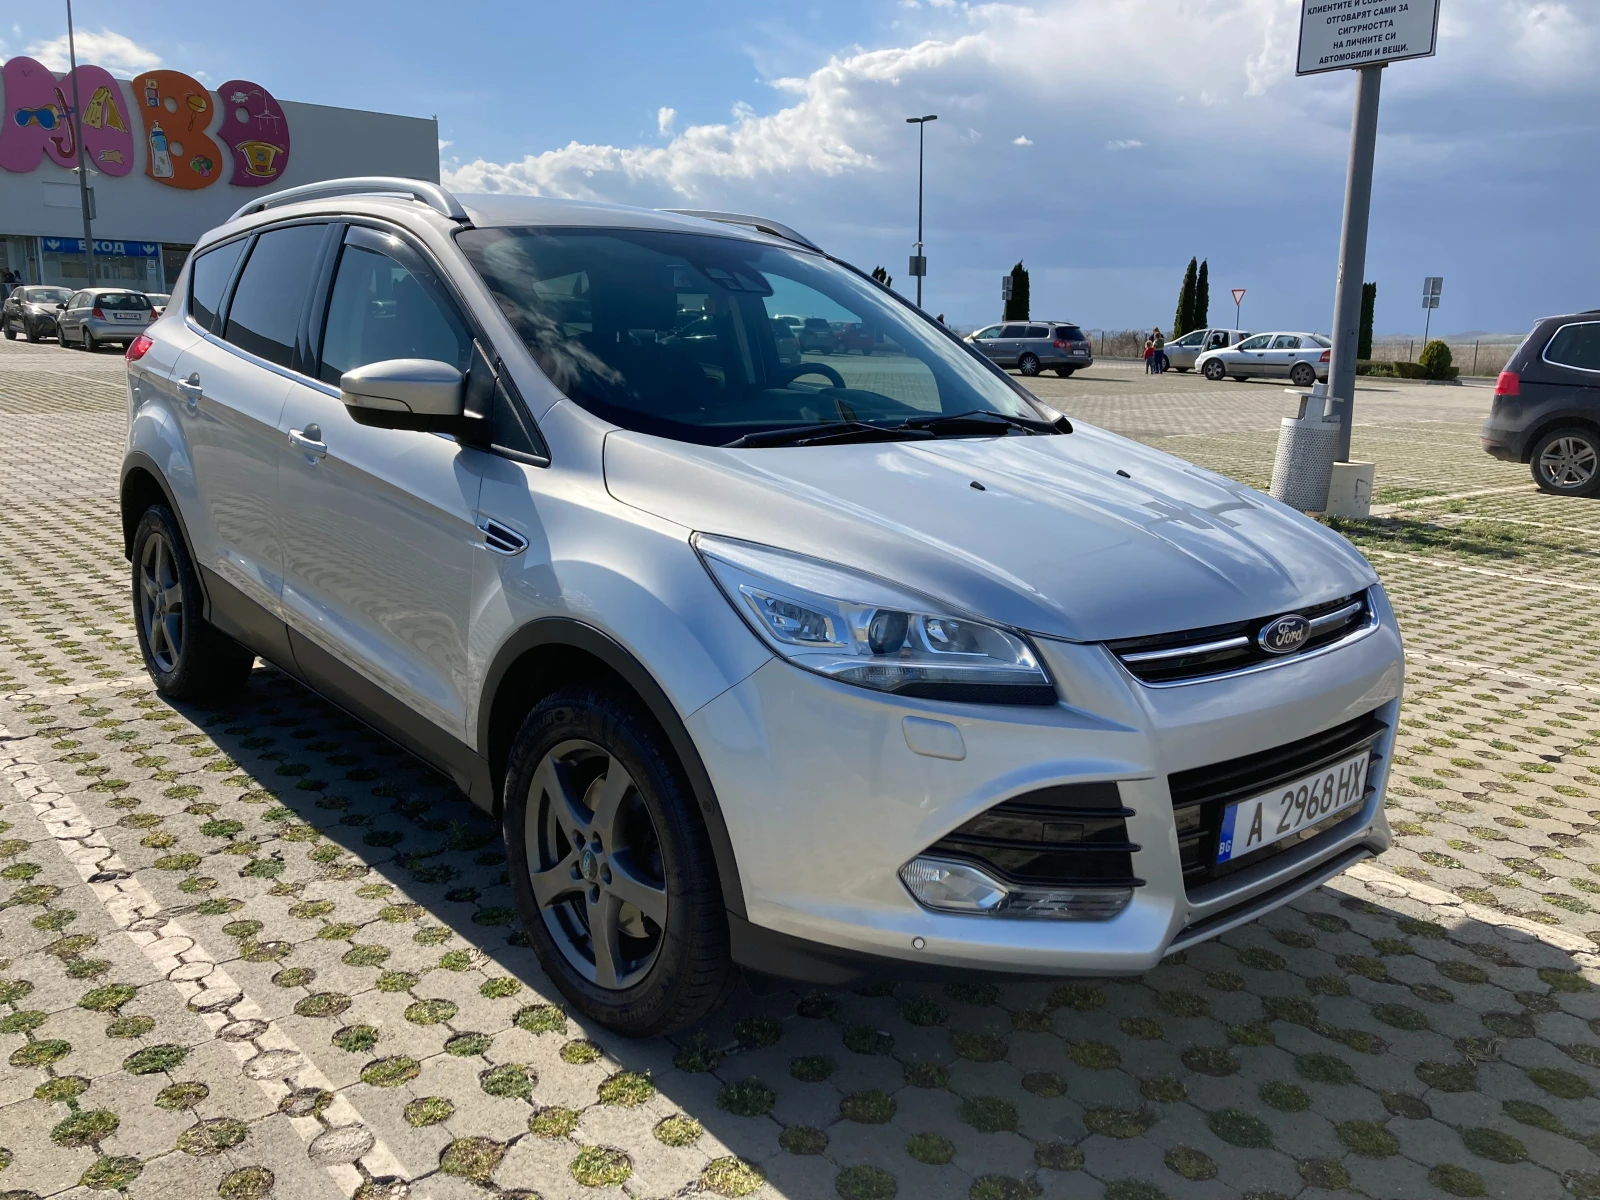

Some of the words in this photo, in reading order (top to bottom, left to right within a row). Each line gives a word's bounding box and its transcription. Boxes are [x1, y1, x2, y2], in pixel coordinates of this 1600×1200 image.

[1307, 1, 1352, 15] КЛИЕНТИТЕ
[1326, 10, 1372, 24] ОТГОВАРЯТ
[1373, 7, 1396, 16] САМИ
[1398, 3, 1409, 12] ЗА
[1337, 19, 1394, 36] СИГУРНОСТТА
[1333, 41, 1344, 49] НА
[1345, 34, 1383, 48] ЛИЧНИТЕ
[1385, 32, 1396, 40] СИ
[1319, 49, 1373, 64] АВТОМОБИЛИ
[1374, 47, 1380, 56] И
[1382, 43, 1409, 55] ВЕЩИ.
[78, 239, 126, 255] ВХОД
[1275, 620, 1304, 647] Ford
[1246, 801, 1263, 847] A
[1218, 839, 1232, 856] BG
